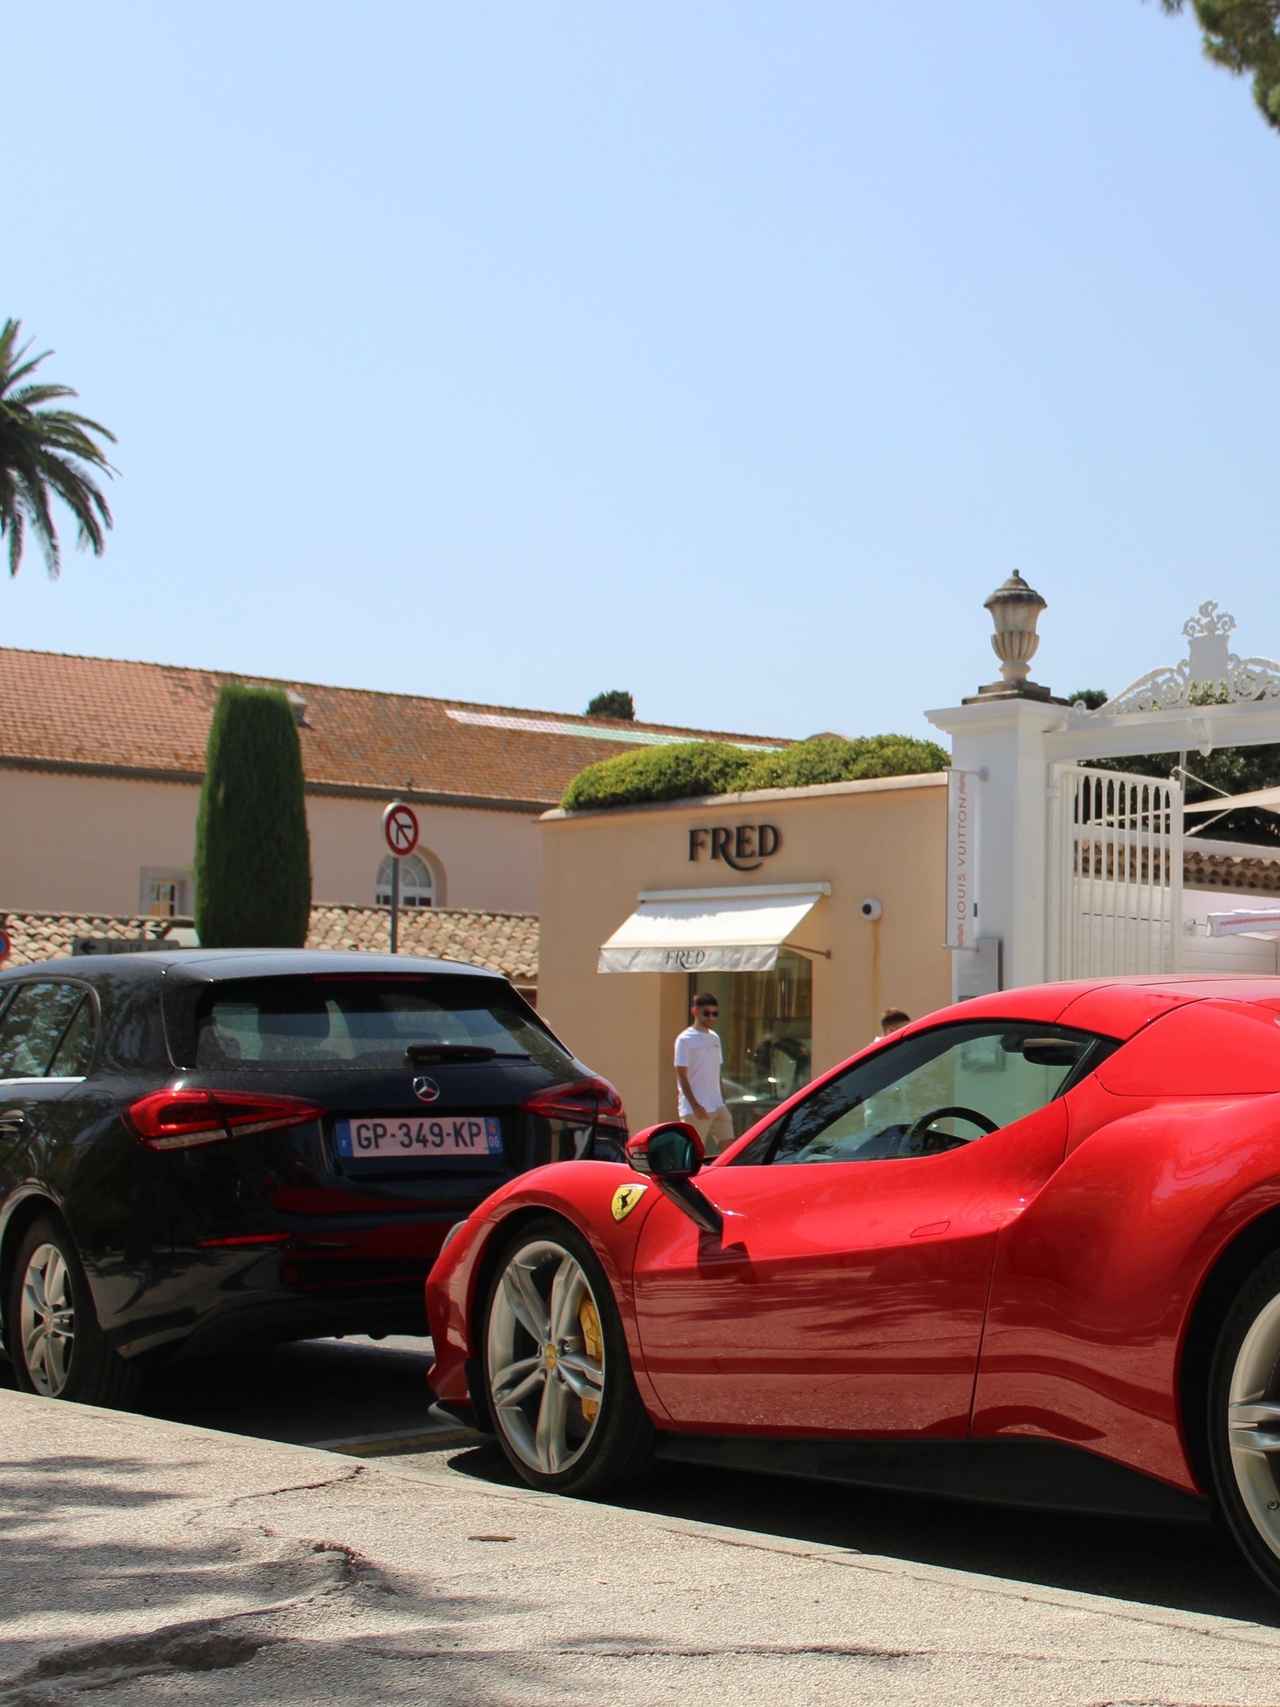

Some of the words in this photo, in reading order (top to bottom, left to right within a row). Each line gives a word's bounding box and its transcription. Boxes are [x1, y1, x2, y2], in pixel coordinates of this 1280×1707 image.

[958, 797, 967, 867] VUITTON
[688, 824, 779, 872] FRED
[957, 873, 966, 921] LOUIS
[665, 950, 706, 970] FRED
[341, 1139, 347, 1149] F
[356, 1121, 482, 1150] GP-349-KP
[489, 1136, 500, 1148] 06
